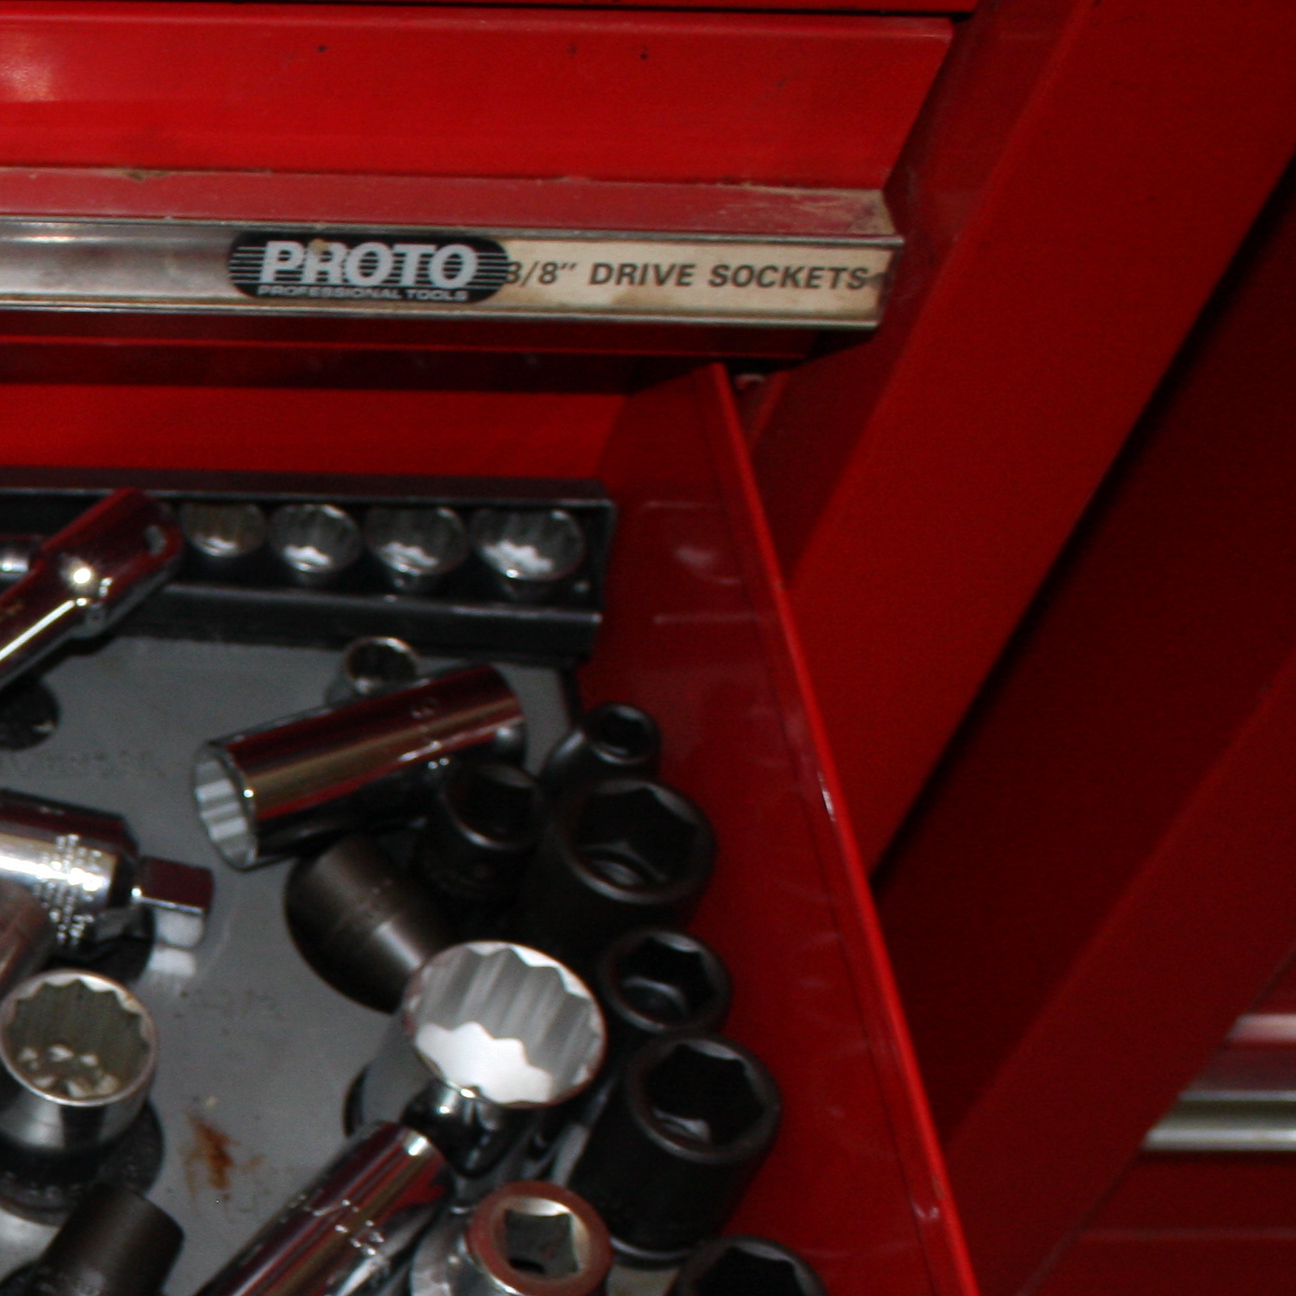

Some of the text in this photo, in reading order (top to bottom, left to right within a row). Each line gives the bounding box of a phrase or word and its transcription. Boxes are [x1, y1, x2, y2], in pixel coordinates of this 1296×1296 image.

[259, 240, 479, 290] PROTO
[589, 262, 697, 287] DRIVE
[708, 264, 870, 291] SOCKETS
[258, 285, 469, 301] PROFESSIONAL TOOLS
